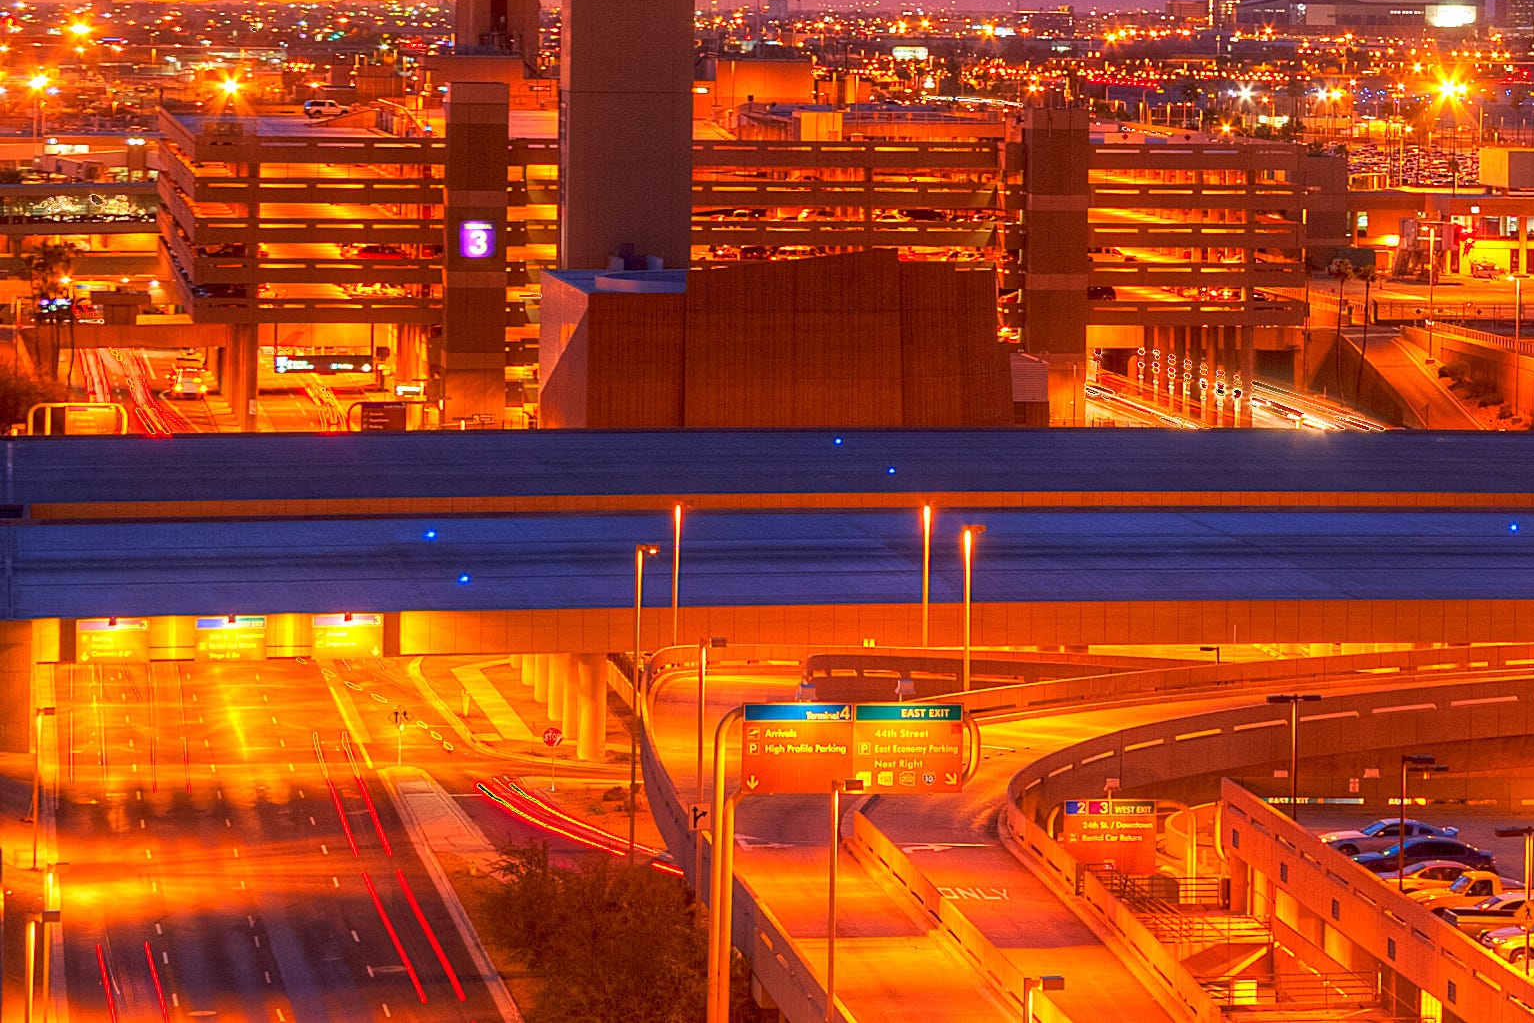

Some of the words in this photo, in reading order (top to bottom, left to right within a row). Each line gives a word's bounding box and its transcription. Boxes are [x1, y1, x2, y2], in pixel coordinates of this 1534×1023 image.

[469, 230, 488, 255] 3
[805, 711, 840, 720] Terminal
[840, 705, 850, 720] 4
[901, 708, 926, 718] EAST
[929, 708, 950, 718] EXIT
[765, 728, 797, 738] Arrivals
[875, 729, 897, 738] 44th
[899, 729, 929, 738] Street
[765, 744, 785, 755] High
[787, 744, 813, 753] Profile
[815, 744, 847, 755] Parking
[874, 744, 891, 753] East
[893, 744, 926, 755] Economy
[928, 744, 959, 755] Parking
[874, 759, 896, 768] Next
[899, 759, 923, 770] Right
[1077, 801, 1086, 814] 2
[1099, 801, 1109, 814] 3
[1114, 805, 1135, 814] WEST
[1136, 805, 1152, 814] EXIT
[1116, 821, 1154, 829] Downtown
[1081, 834, 1104, 842] Rental
[1105, 834, 1118, 842] Car
[1119, 834, 1143, 842] Return
[936, 887, 1010, 901] ONLY
